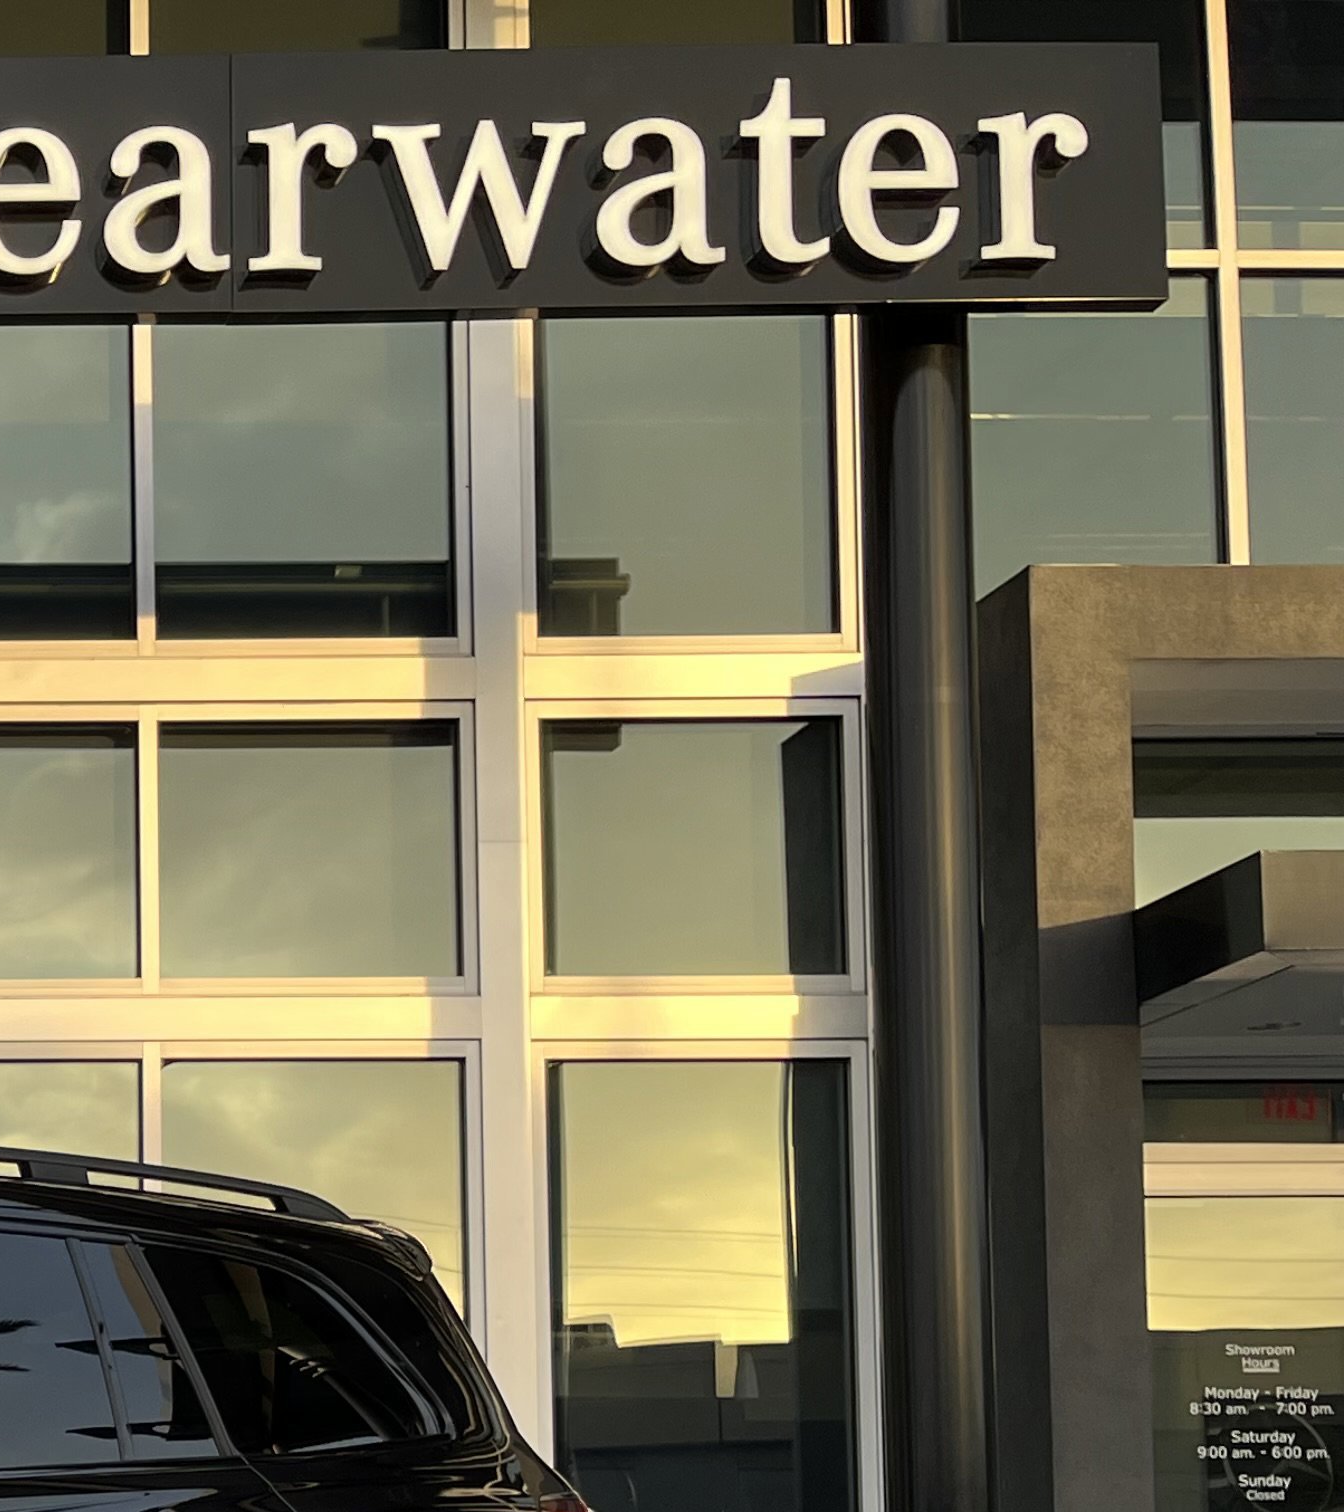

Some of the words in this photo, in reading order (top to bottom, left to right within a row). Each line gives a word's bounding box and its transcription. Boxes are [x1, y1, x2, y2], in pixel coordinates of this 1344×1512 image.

[1225, 1343, 1295, 1356] Showroom
[1242, 1357, 1280, 1369] Hours
[1204, 1386, 1260, 1402] Monday
[1275, 1386, 1319, 1401] Friday
[1189, 1402, 1221, 1415] 8:30
[1276, 1402, 1306, 1415] 7:00
[1230, 1430, 1296, 1445] Saturday
[1238, 1474, 1292, 1489] Sunday
[1246, 1490, 1285, 1501] Closed
